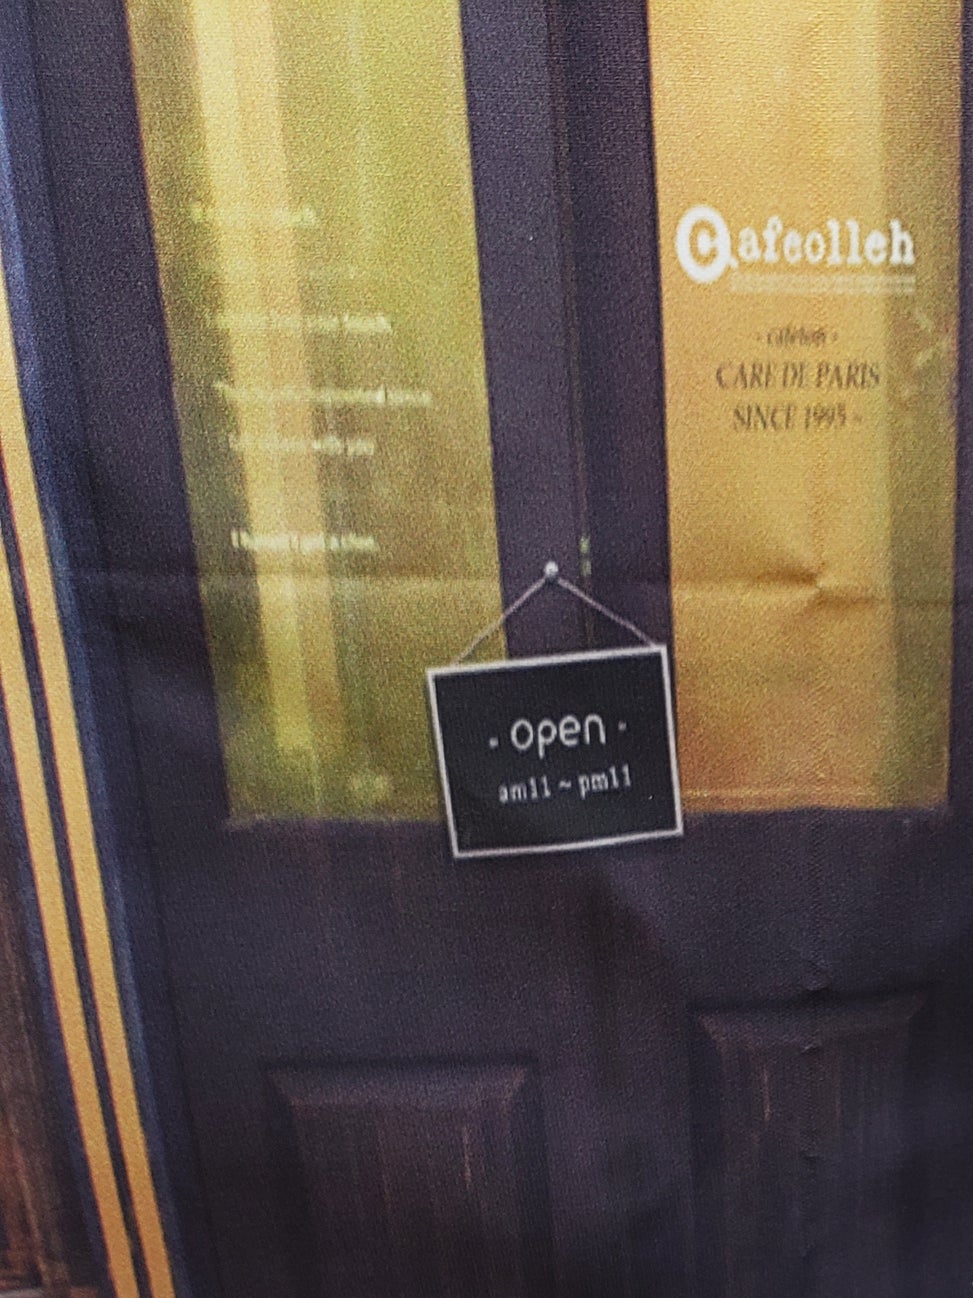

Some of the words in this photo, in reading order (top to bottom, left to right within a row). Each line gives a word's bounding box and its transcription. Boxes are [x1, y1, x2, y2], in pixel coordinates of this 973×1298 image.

[813, 360, 882, 390] PARIS
[732, 403, 797, 431] SINCE
[510, 713, 606, 759] open
